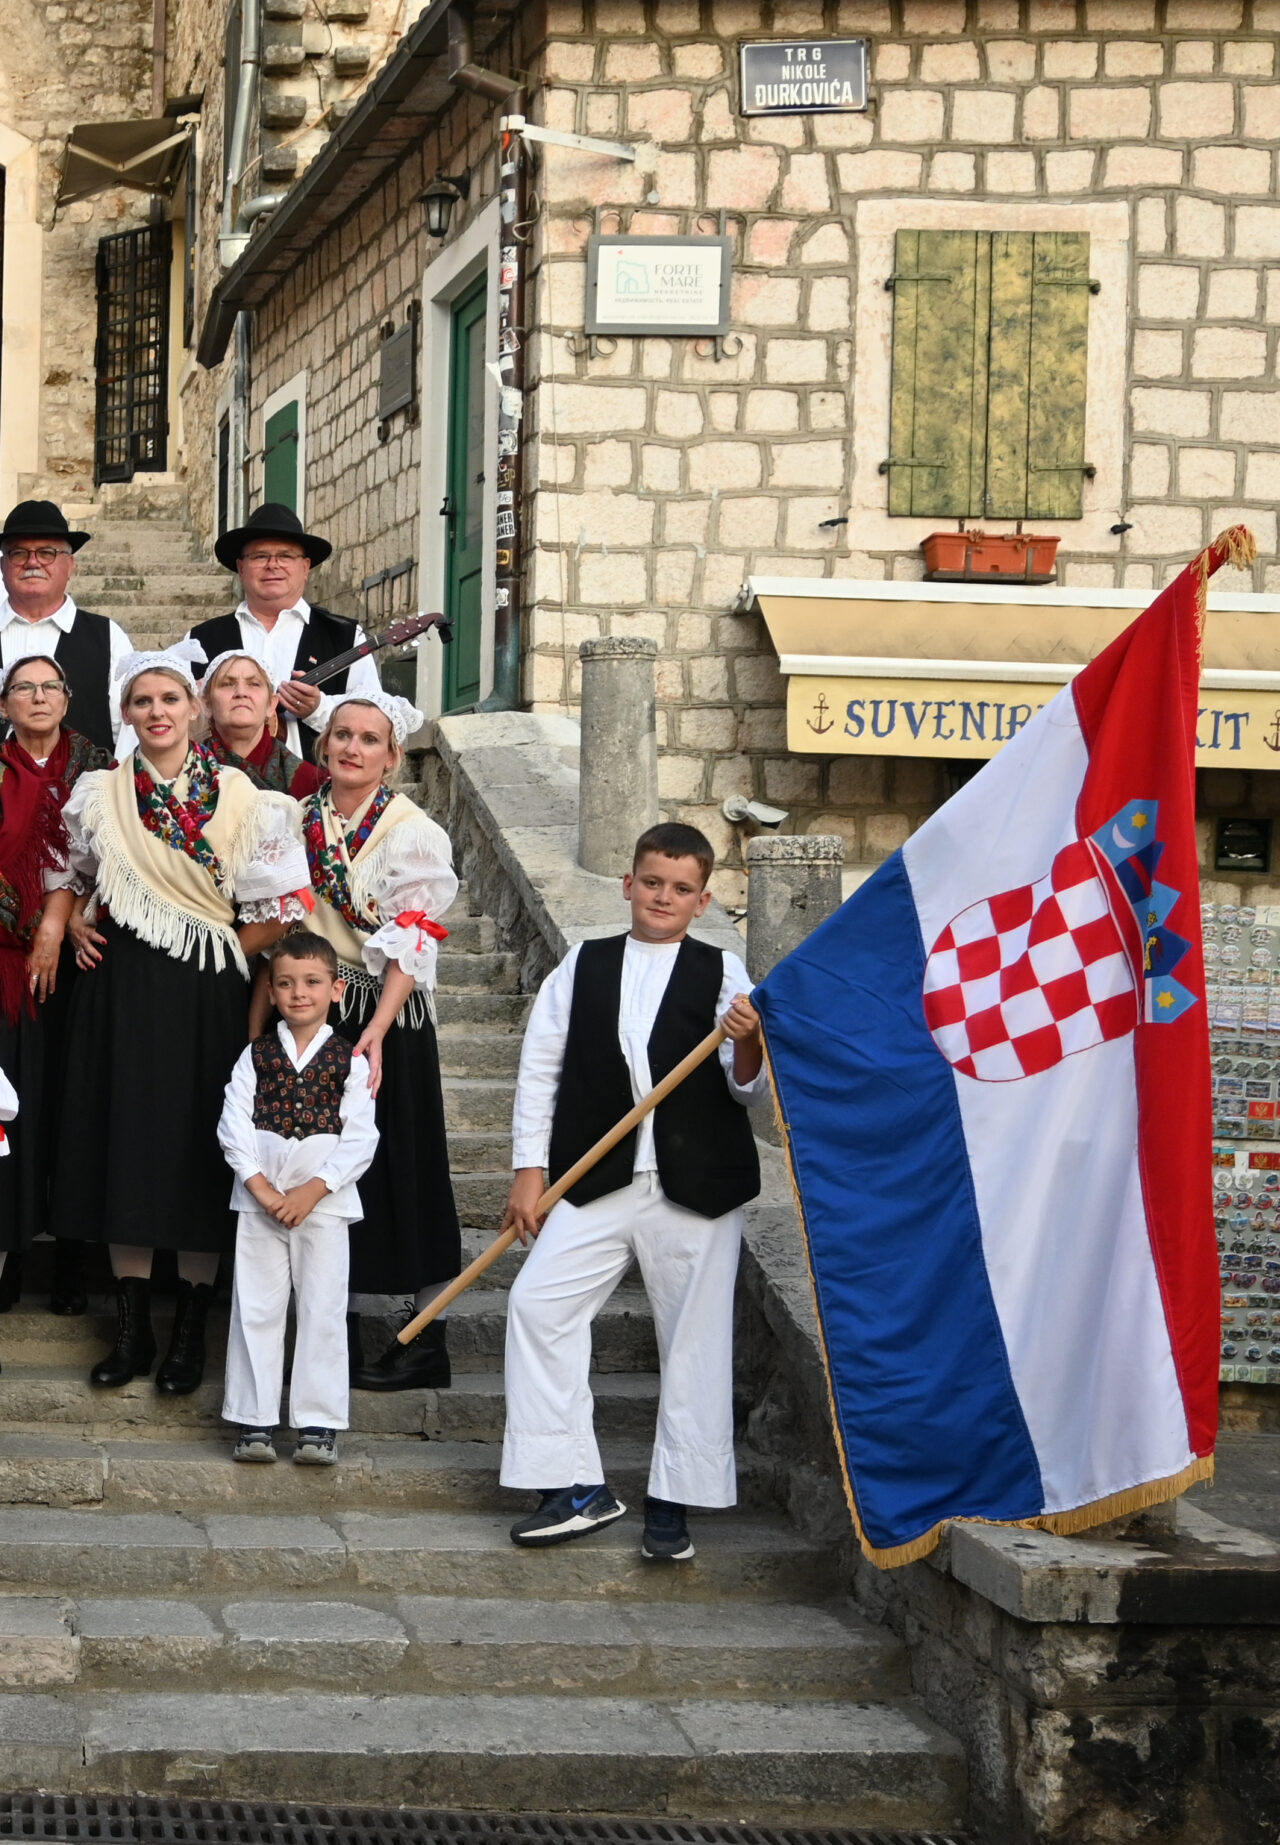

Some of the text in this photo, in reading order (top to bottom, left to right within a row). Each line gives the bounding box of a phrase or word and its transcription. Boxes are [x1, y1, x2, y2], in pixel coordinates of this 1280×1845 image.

[785, 47, 822, 62] TRG
[781, 63, 827, 80] NIKOLE
[754, 78, 854, 107] ĐURKOVIĆA
[654, 264, 703, 276] FORTE
[661, 276, 703, 287] MARE
[844, 699, 1045, 742] SUVENIR
